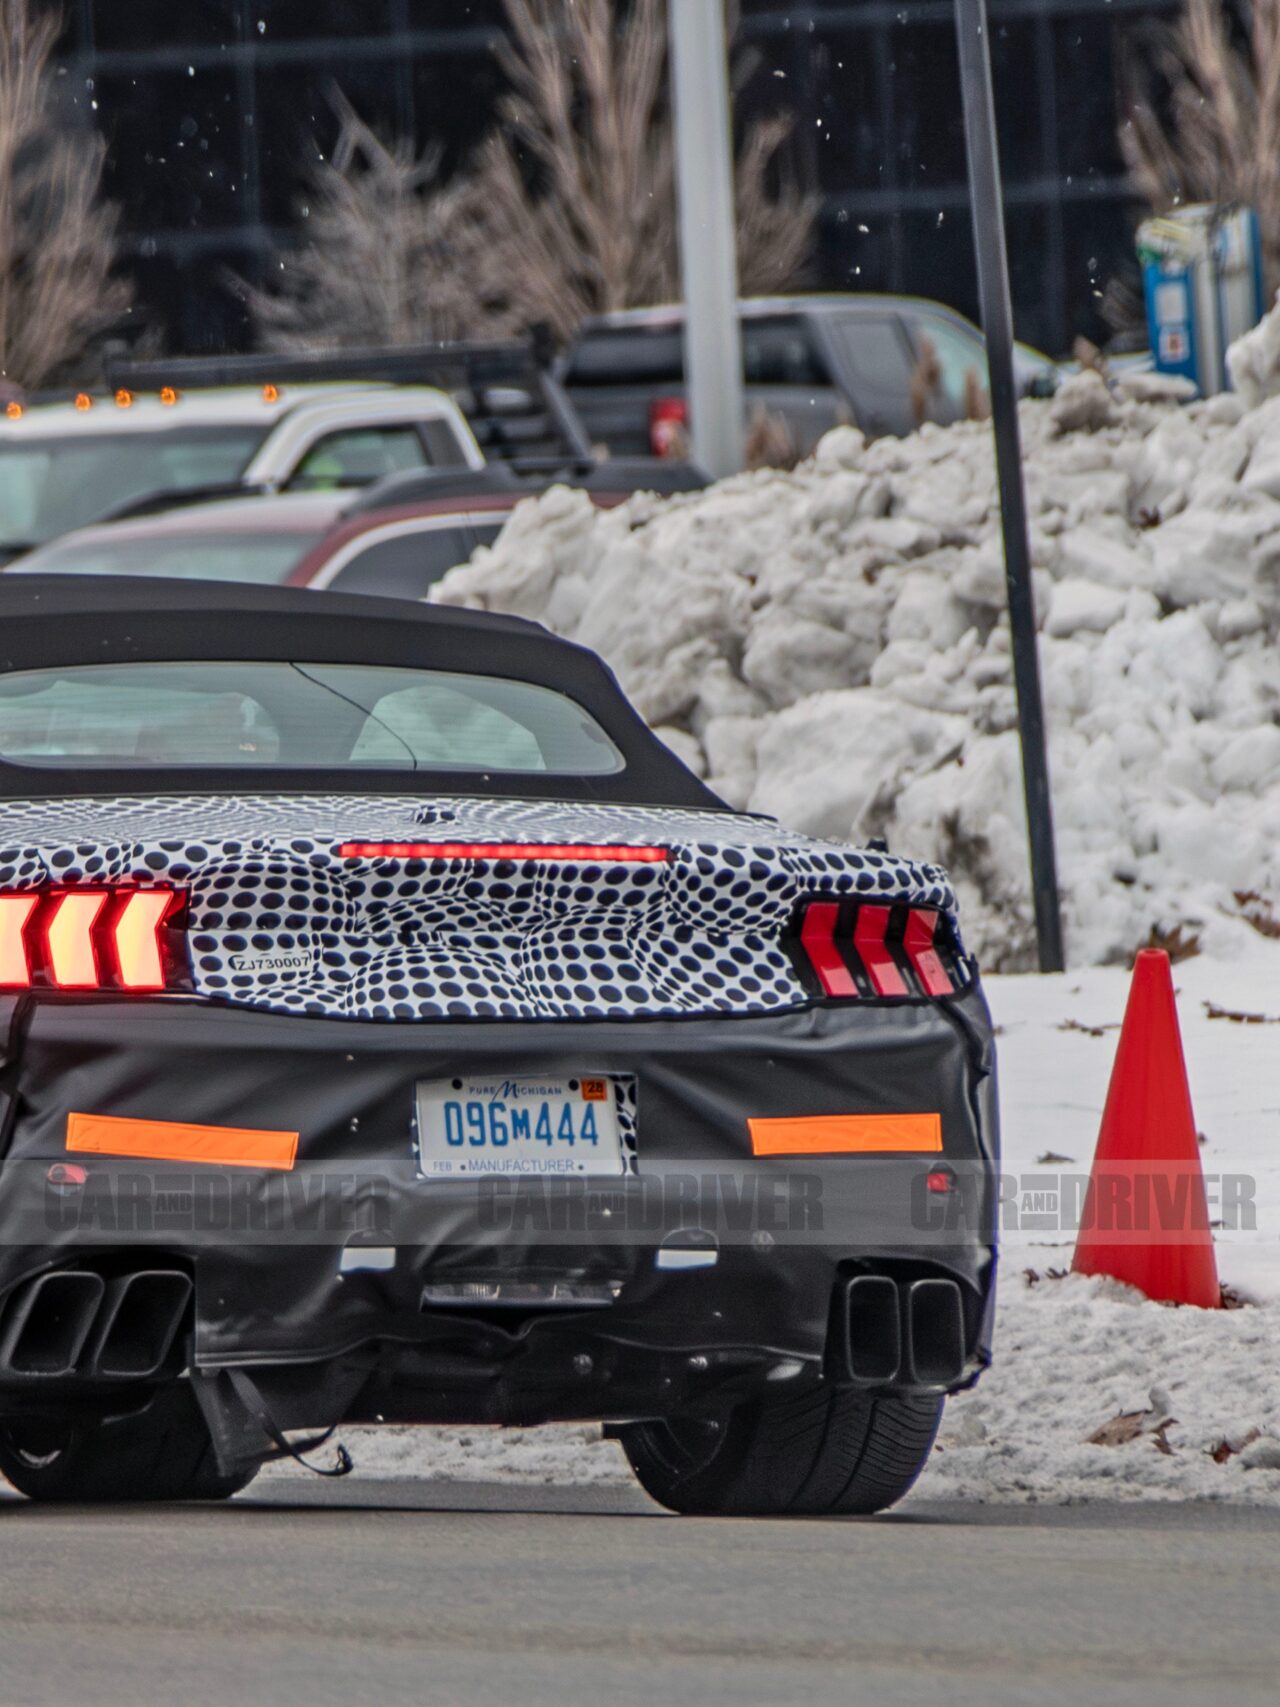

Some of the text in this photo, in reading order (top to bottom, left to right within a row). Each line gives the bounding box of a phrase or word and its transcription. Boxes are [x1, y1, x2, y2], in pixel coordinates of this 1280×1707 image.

[237, 957, 309, 970] ZJ730007
[469, 1086, 495, 1095] PURE
[444, 1102, 599, 1146] 096M444
[433, 1159, 575, 1172] FEB MANUFACTURER
